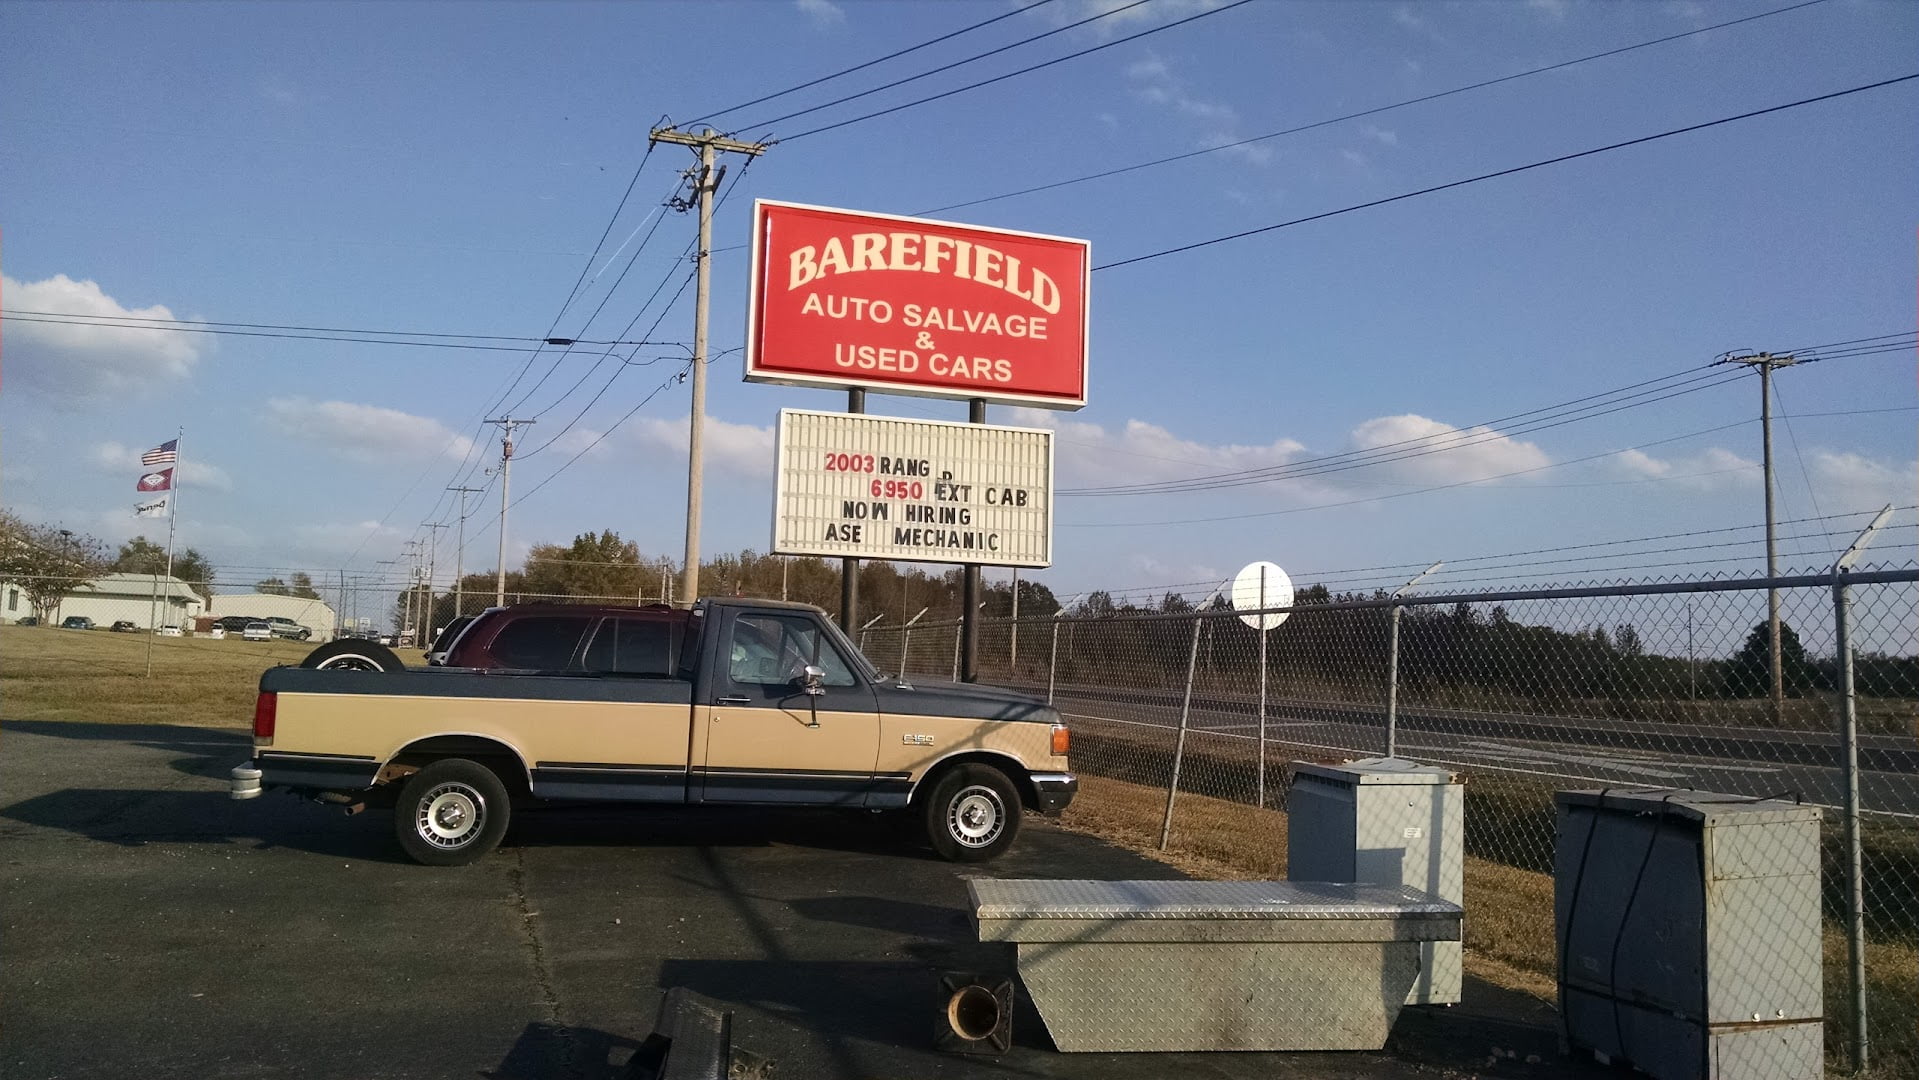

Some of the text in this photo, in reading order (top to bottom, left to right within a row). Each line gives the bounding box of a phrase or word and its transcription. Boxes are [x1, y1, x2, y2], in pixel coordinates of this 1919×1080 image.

[788, 232, 1061, 314] BAREFIELD
[801, 292, 1048, 340] AUTO SALVAGE
[915, 331, 935, 350] &
[835, 343, 1013, 383] USED CARS
[825, 453, 874, 473] 2003
[880, 456, 930, 476] RANG
[870, 479, 1028, 507] 6950 EXT CAB
[843, 501, 971, 525] NOW HIRING
[825, 523, 999, 551] ASE MECHANIC
